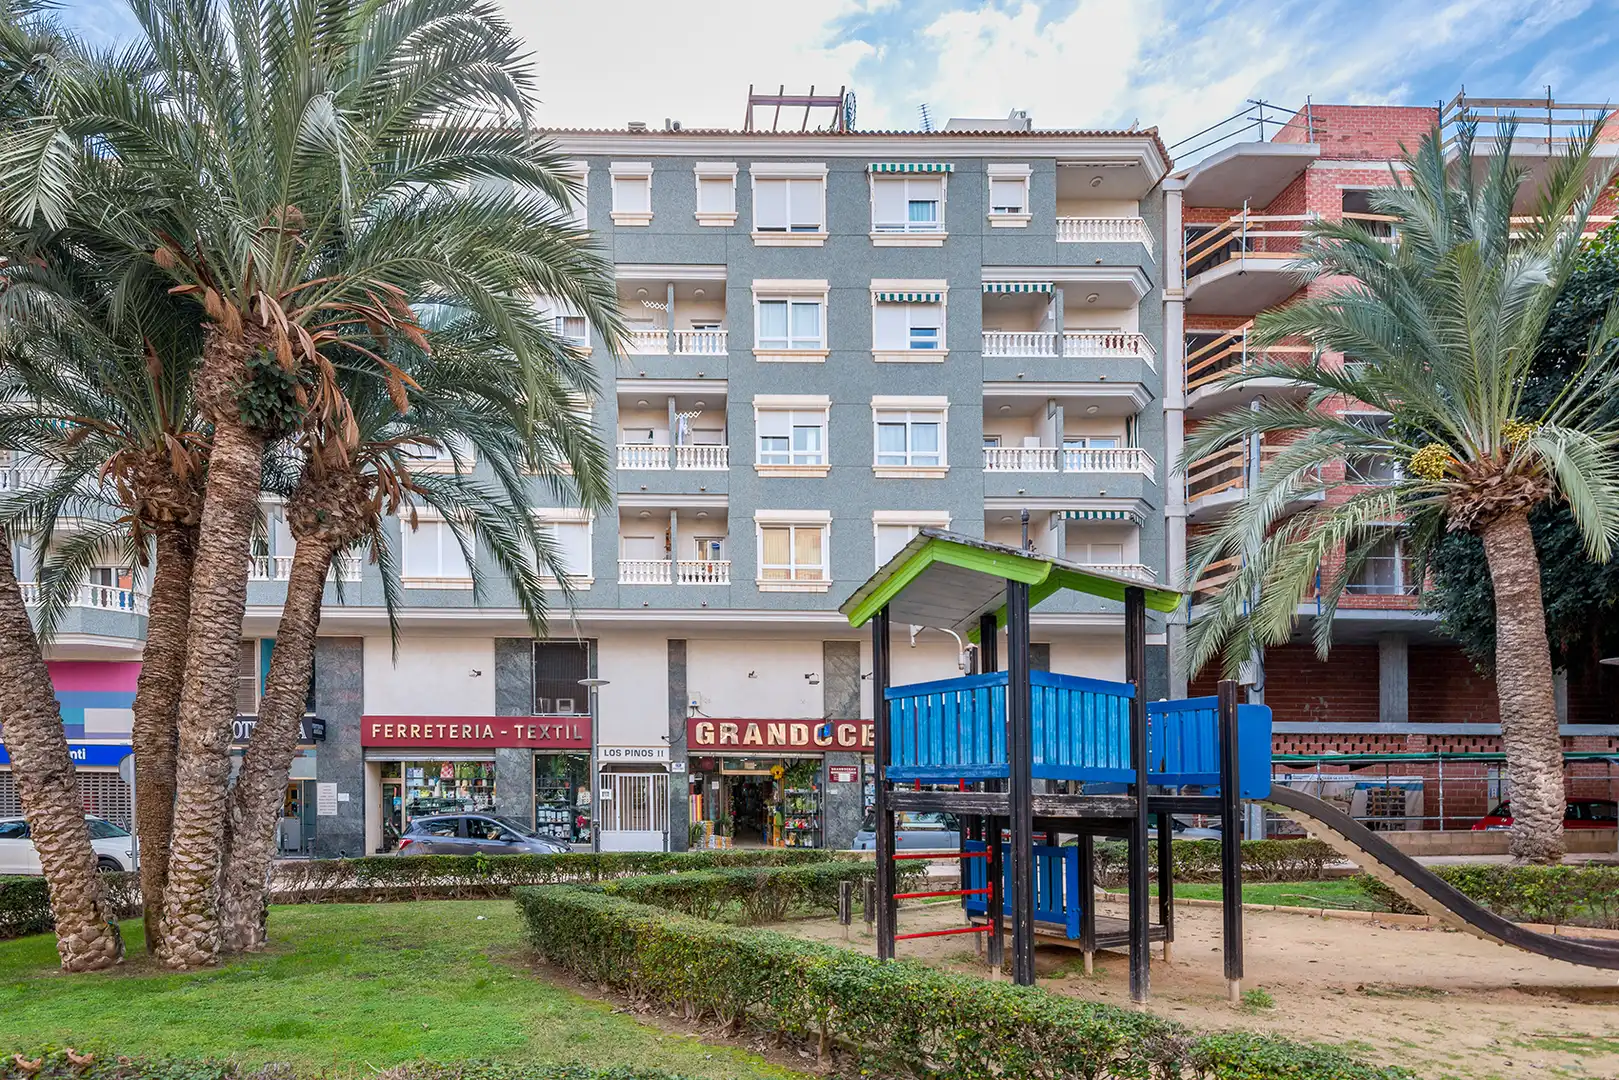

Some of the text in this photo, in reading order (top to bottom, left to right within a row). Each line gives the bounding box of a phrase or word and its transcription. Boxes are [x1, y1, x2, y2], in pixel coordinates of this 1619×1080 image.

[372, 724, 494, 739] FERRETERIA
[513, 725, 582, 740] TEXTIL
[604, 749, 621, 757] LOS
[624, 749, 653, 757] PINOS
